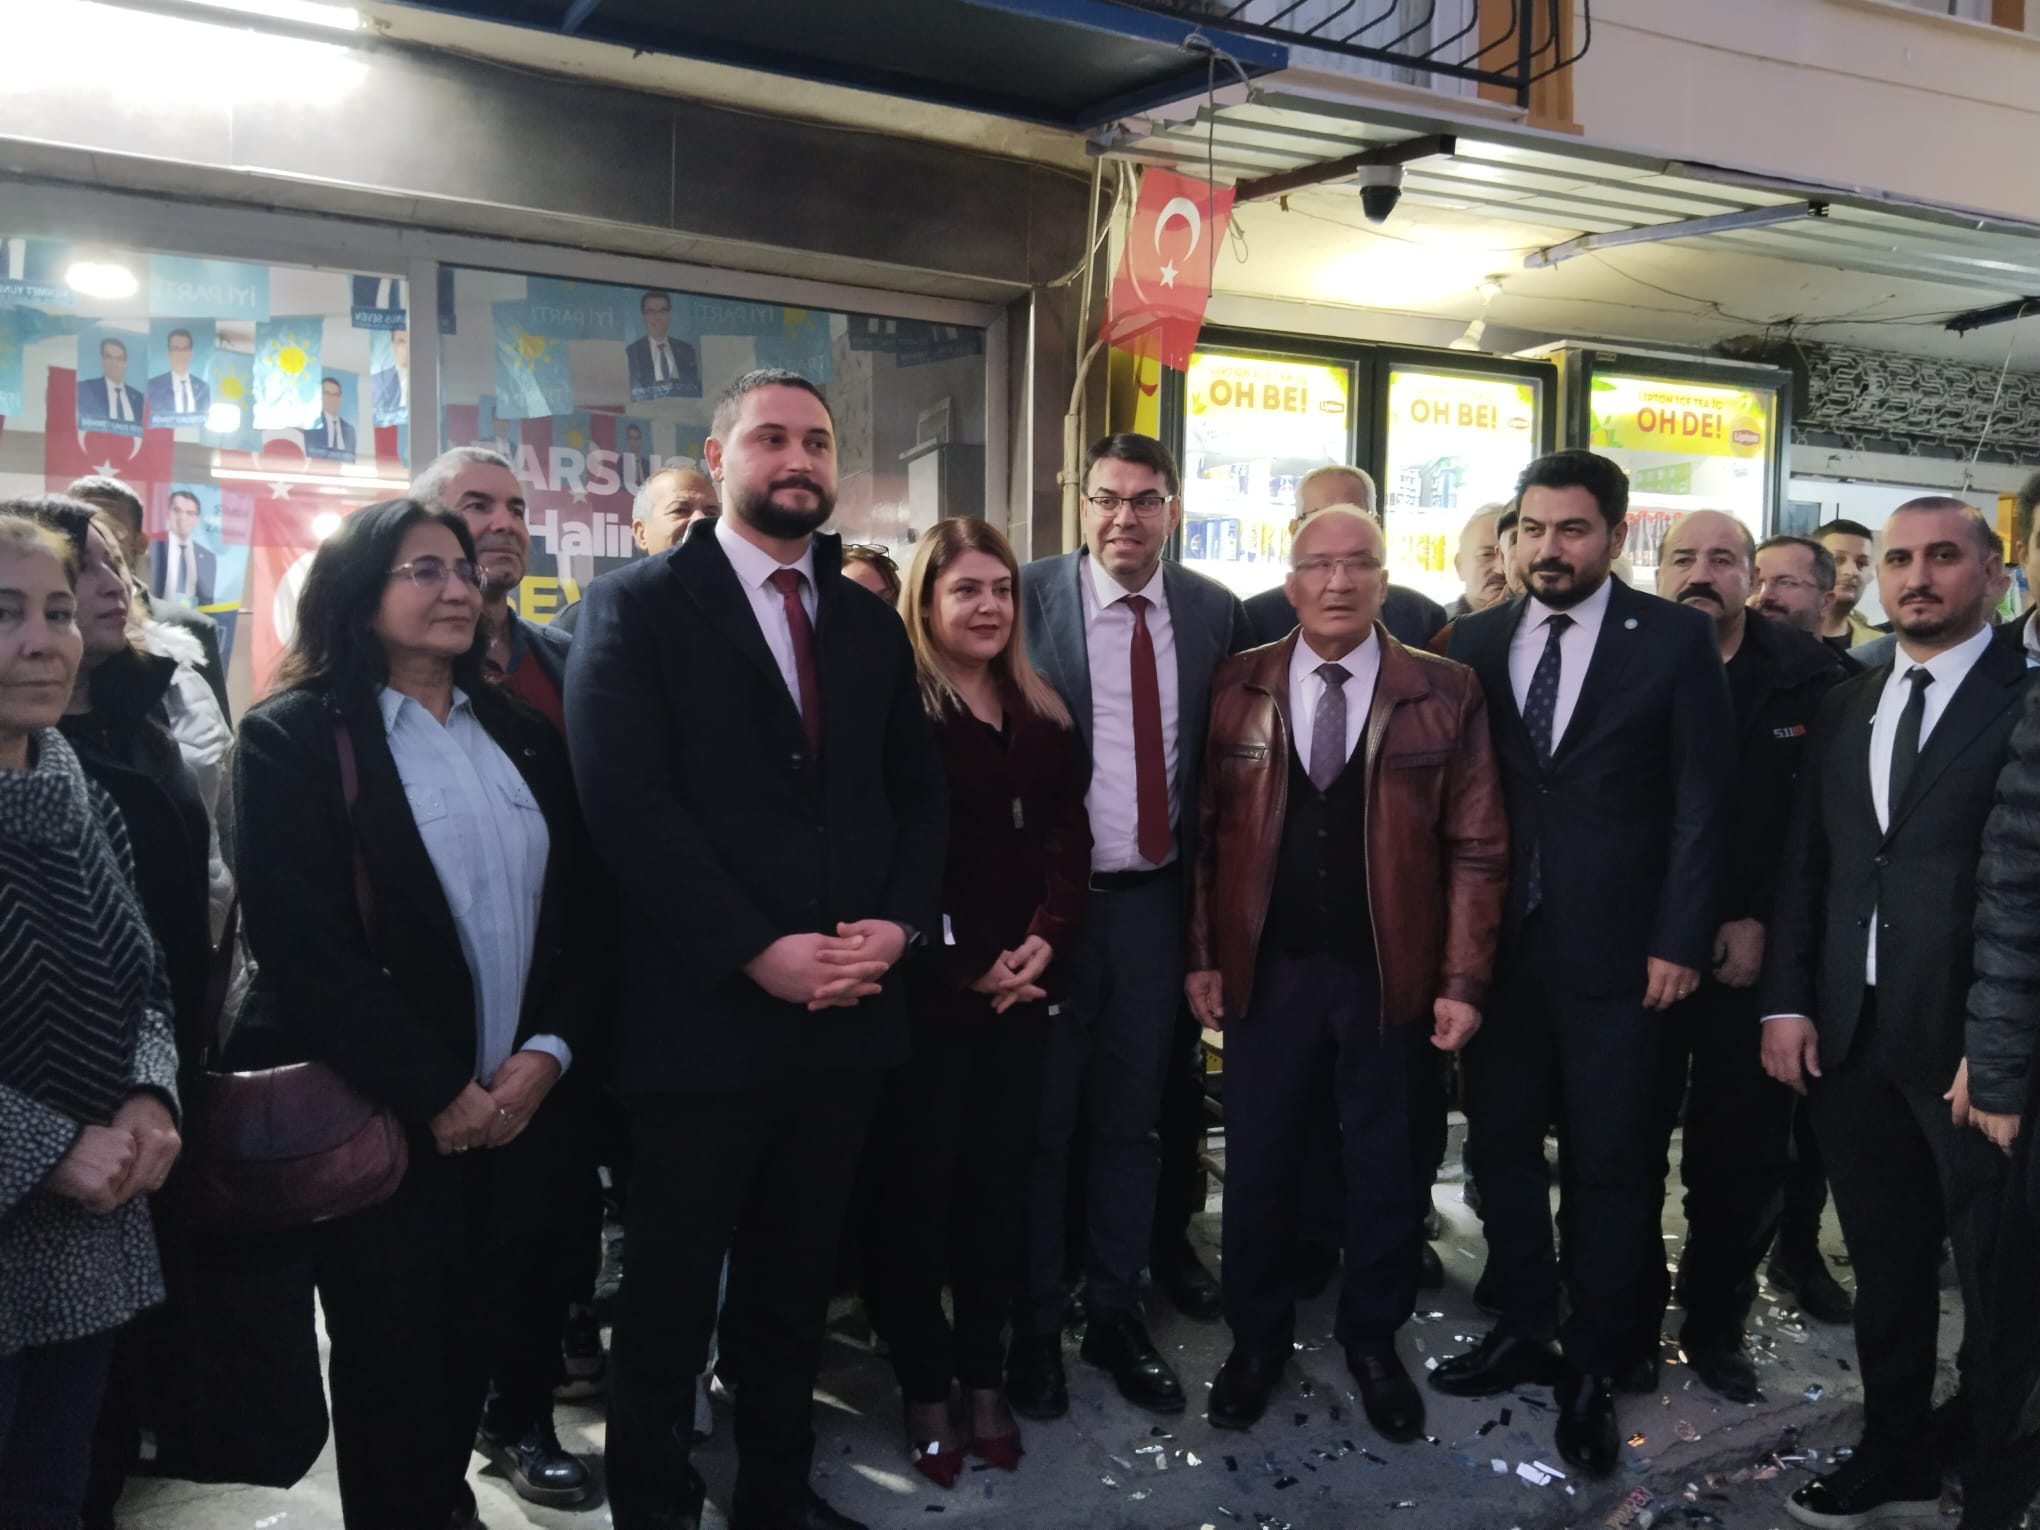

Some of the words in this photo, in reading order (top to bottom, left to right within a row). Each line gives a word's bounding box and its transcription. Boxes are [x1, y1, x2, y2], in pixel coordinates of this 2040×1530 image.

[1209, 379, 1255, 409] OH
[1262, 384, 1308, 413] BE!
[1410, 397, 1450, 425] OH
[1457, 402, 1498, 430] BE!
[1636, 406, 1677, 436] OH
[1681, 411, 1723, 439] DE!
